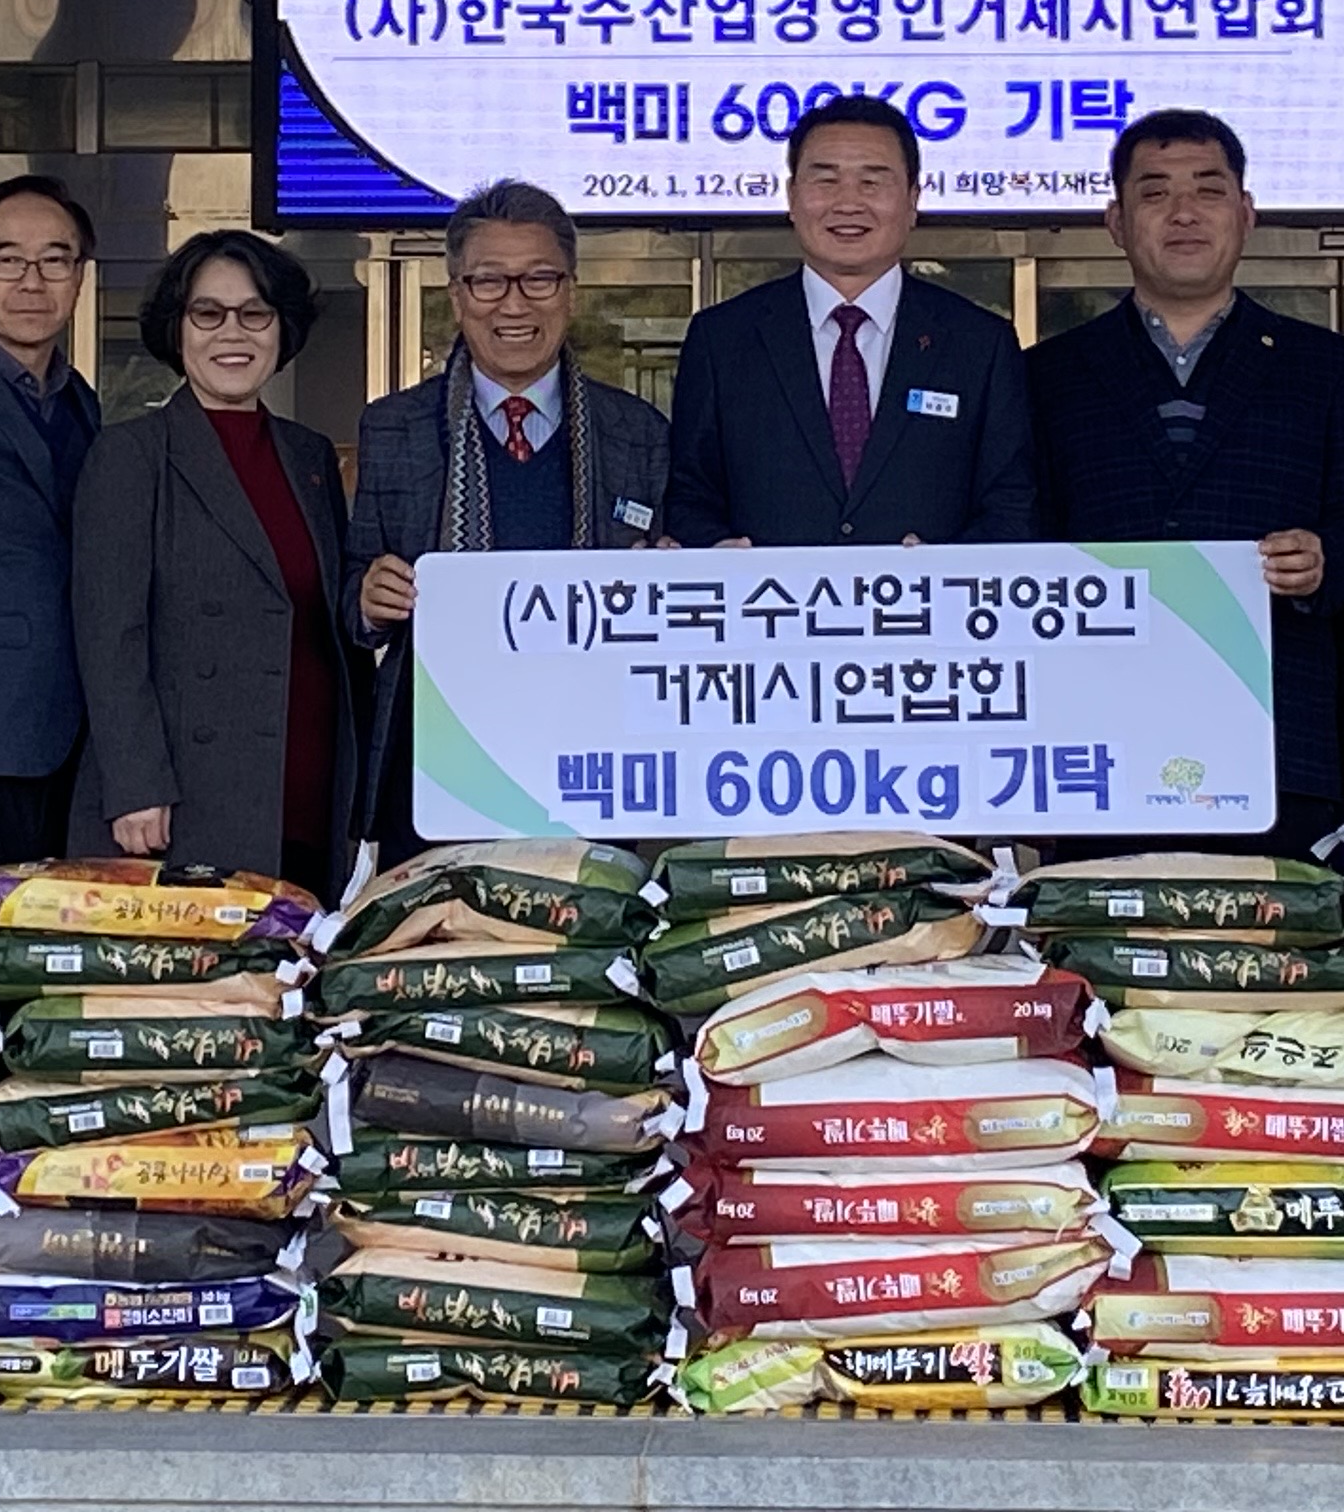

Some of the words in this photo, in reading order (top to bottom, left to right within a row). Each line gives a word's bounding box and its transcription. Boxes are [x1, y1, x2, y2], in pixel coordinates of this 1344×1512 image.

[566, 82, 690, 143] 백미
[712, 81, 967, 142] 60G
[1005, 79, 1135, 142] 기탁
[583, 174, 658, 197] 2024.
[922, 170, 945, 197] 시
[629, 657, 1029, 724] 거제시연합회
[557, 750, 678, 820] 백미
[705, 749, 962, 821] 600kg
[988, 744, 1115, 814] 기탁
[871, 1000, 956, 1026] 메뚜기쌀
[94, 1345, 223, 1382] 메뚜기쌀
[828, 1341, 995, 1385] 향메뚜기쌀
